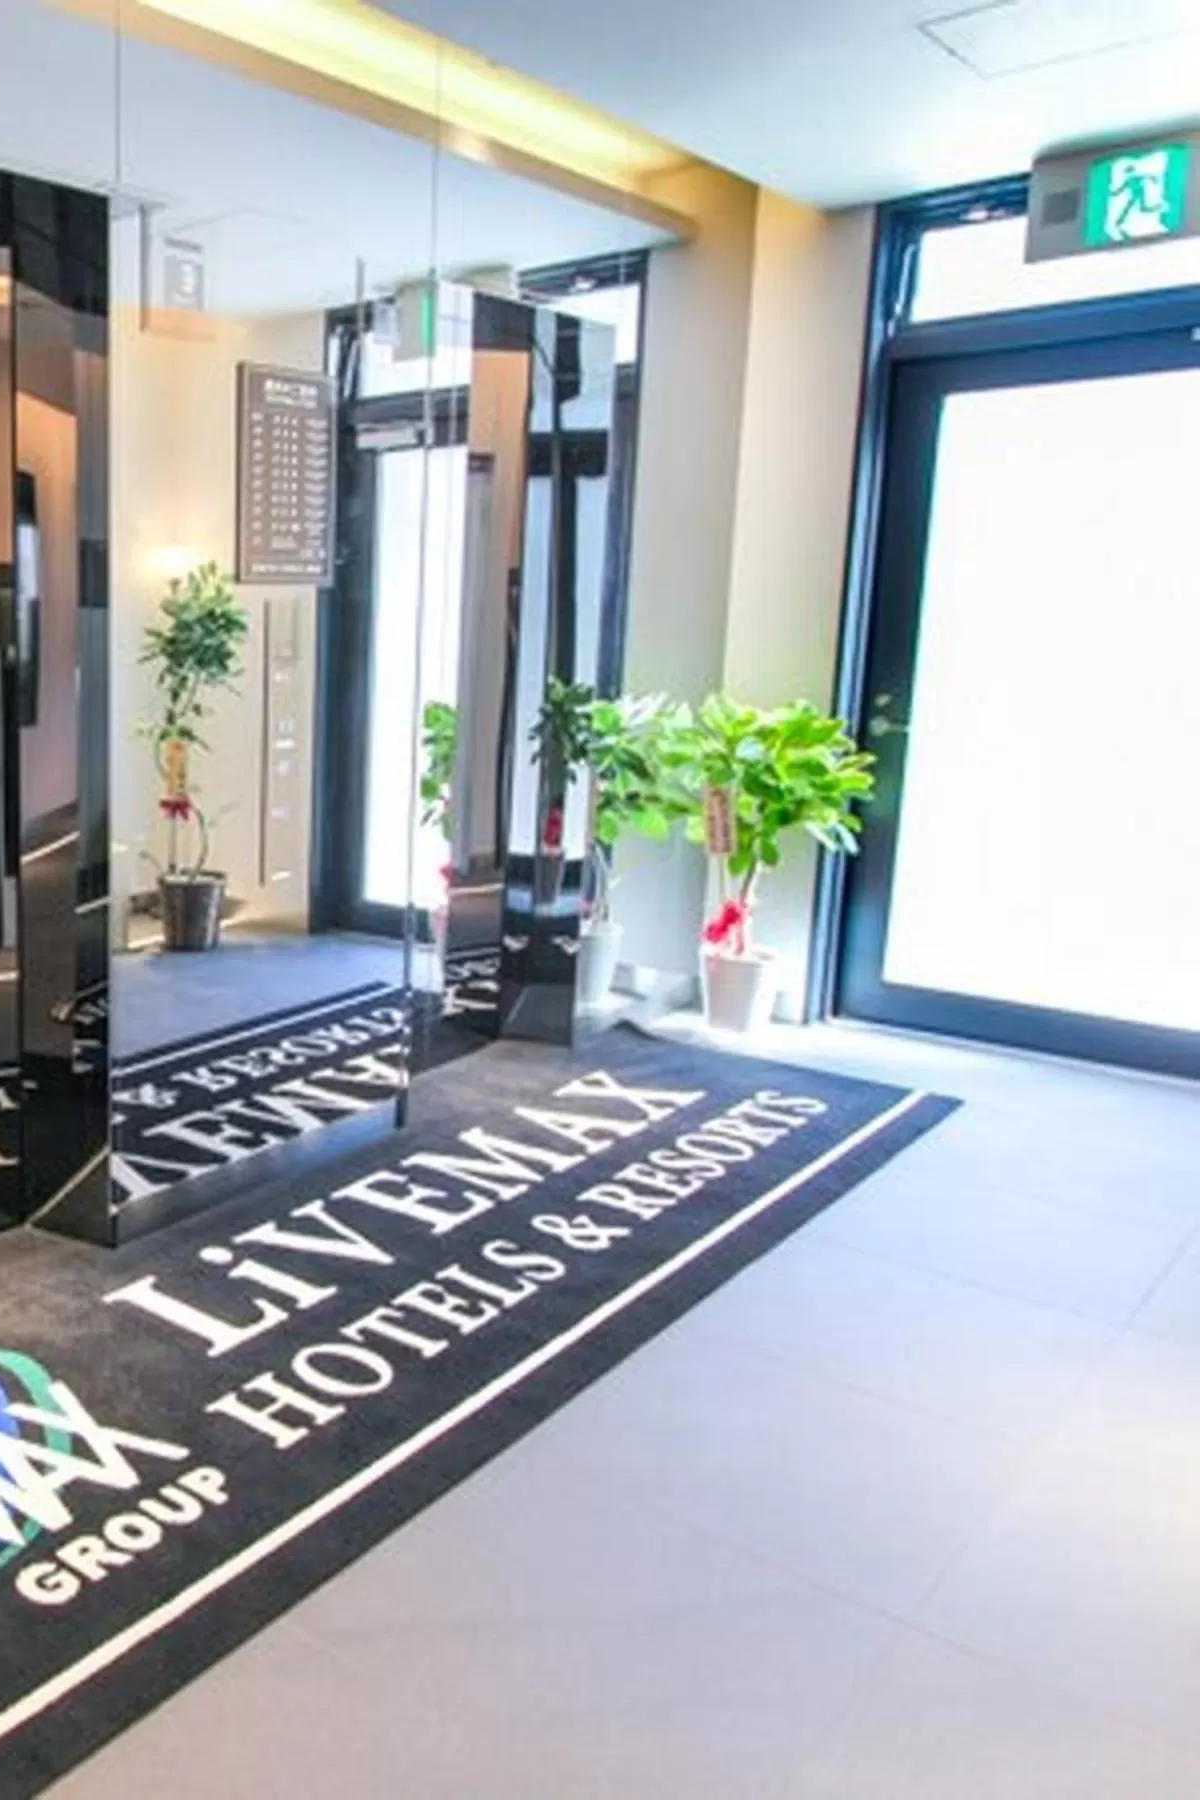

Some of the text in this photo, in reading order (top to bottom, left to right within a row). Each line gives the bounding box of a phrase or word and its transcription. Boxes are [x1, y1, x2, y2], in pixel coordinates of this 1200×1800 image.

[102, 1070, 707, 1358] LiVEMAX
[205, 1090, 828, 1450] HOTELS & RESORTS
[15, 1466, 230, 1606] GROUP
